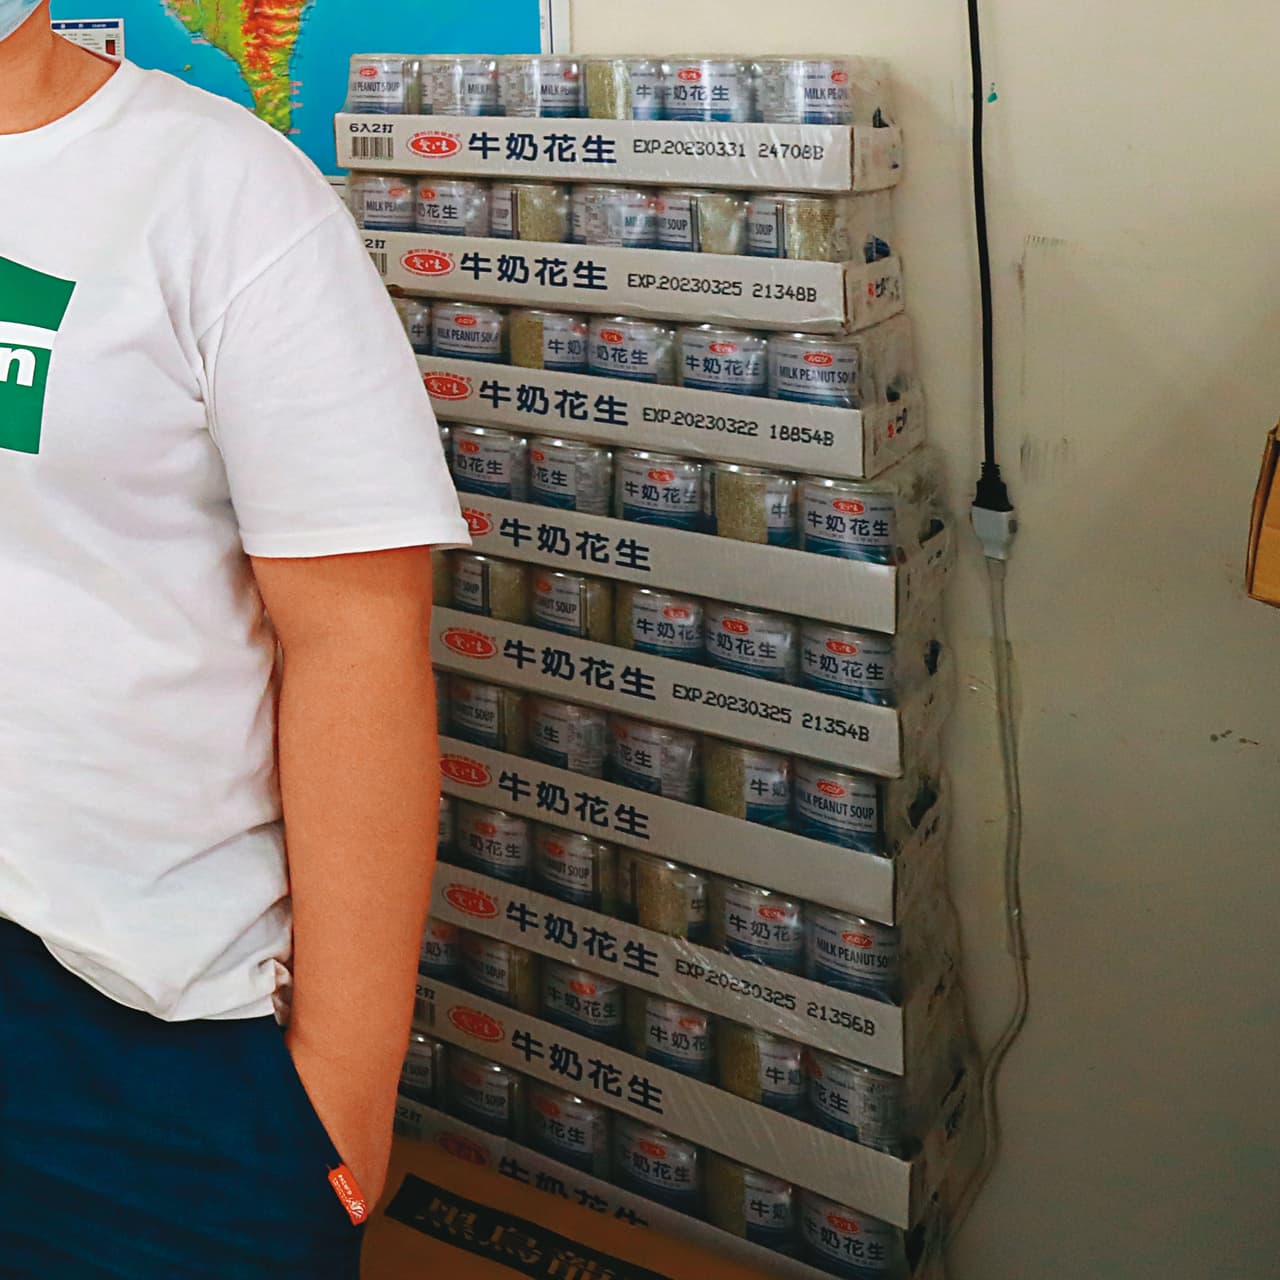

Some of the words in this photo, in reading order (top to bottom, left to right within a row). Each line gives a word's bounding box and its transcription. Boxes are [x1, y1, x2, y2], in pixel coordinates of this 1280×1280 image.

[468, 131, 617, 165] 牛奶花生
[460, 252, 608, 292] 牛奶花生
[800, 367, 835, 383] PEANUT
[478, 380, 630, 426] 牛奶花生
[499, 517, 652, 573] 牛奶花生
[807, 511, 890, 538] 牛奶花生
[503, 639, 657, 701] 牛奶花生
[805, 648, 885, 681] 牛奶花生
[498, 771, 651, 839] 牛奶花生
[812, 794, 849, 817] PEANUT
[850, 802, 875, 820] SOUP
[505, 900, 661, 978] 牛奶花生
[511, 1028, 665, 1115] 牛奶花生
